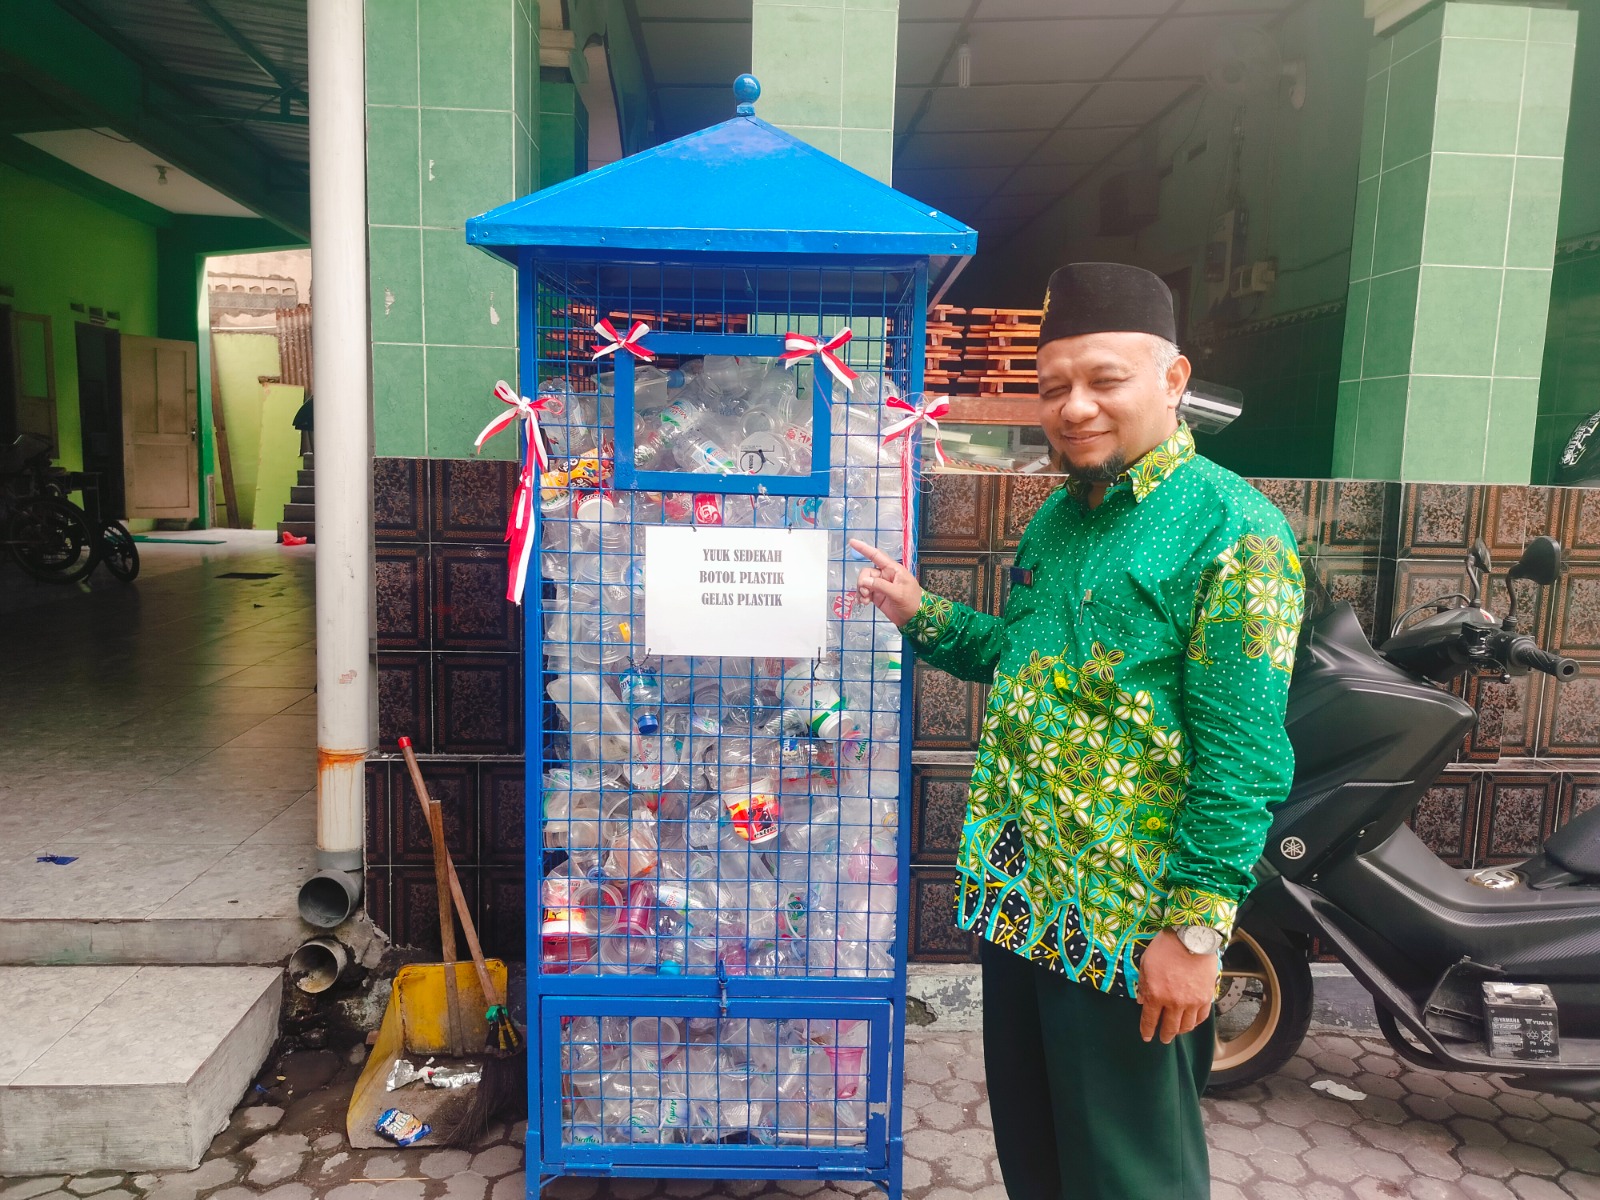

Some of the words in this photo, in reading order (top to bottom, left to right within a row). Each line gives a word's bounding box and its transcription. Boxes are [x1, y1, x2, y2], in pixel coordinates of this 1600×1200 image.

[702, 548, 730, 562] YUUK
[733, 549, 783, 563] SEDEKAH
[699, 570, 736, 584] BOTOL
[739, 571, 785, 585] PLASTIK
[701, 592, 734, 606] GELAS
[737, 593, 783, 607] PLASTIK
